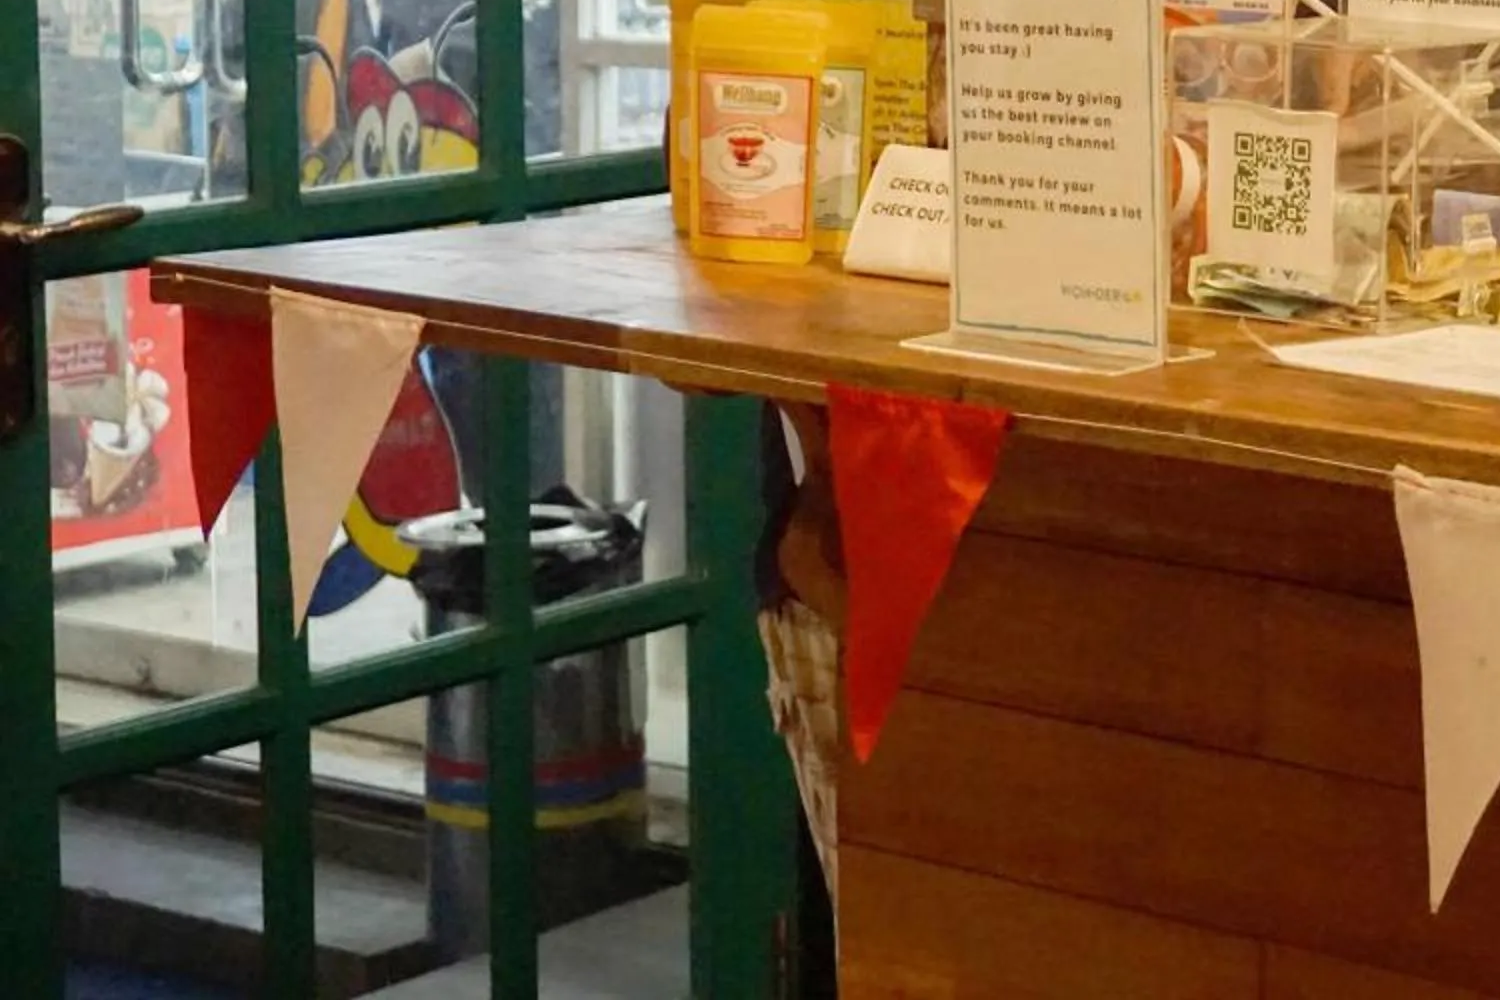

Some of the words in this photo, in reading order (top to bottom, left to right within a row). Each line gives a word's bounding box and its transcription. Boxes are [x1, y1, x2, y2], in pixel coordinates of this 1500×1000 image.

[959, 18, 982, 33] It's
[985, 19, 1019, 34] been
[1023, 22, 1060, 39] great
[1064, 22, 1114, 41] having
[960, 43, 986, 56] you
[988, 43, 1019, 60] stay
[960, 83, 994, 99] Help
[997, 88, 1013, 100] us
[1016, 88, 1051, 102] grow
[1055, 88, 1073, 106] by
[1077, 91, 1123, 108] giving
[961, 109, 978, 120] us
[981, 106, 1004, 121] the
[1008, 108, 1038, 124] best
[1042, 112, 1090, 126] review
[1093, 116, 1112, 128] on
[962, 131, 993, 144] your
[996, 130, 1053, 148] booking
[889, 177, 931, 194] CHECK
[963, 170, 1005, 186] Thank
[1009, 176, 1034, 190] you
[1038, 176, 1059, 190] for
[1062, 180, 1095, 194] your
[871, 201, 913, 218] CHECK
[917, 206, 945, 224] OUT
[1043, 199, 1055, 213] It
[1059, 202, 1106, 217] means
[1109, 207, 1118, 218] a
[1121, 205, 1143, 220] lot
[963, 213, 984, 228] for
